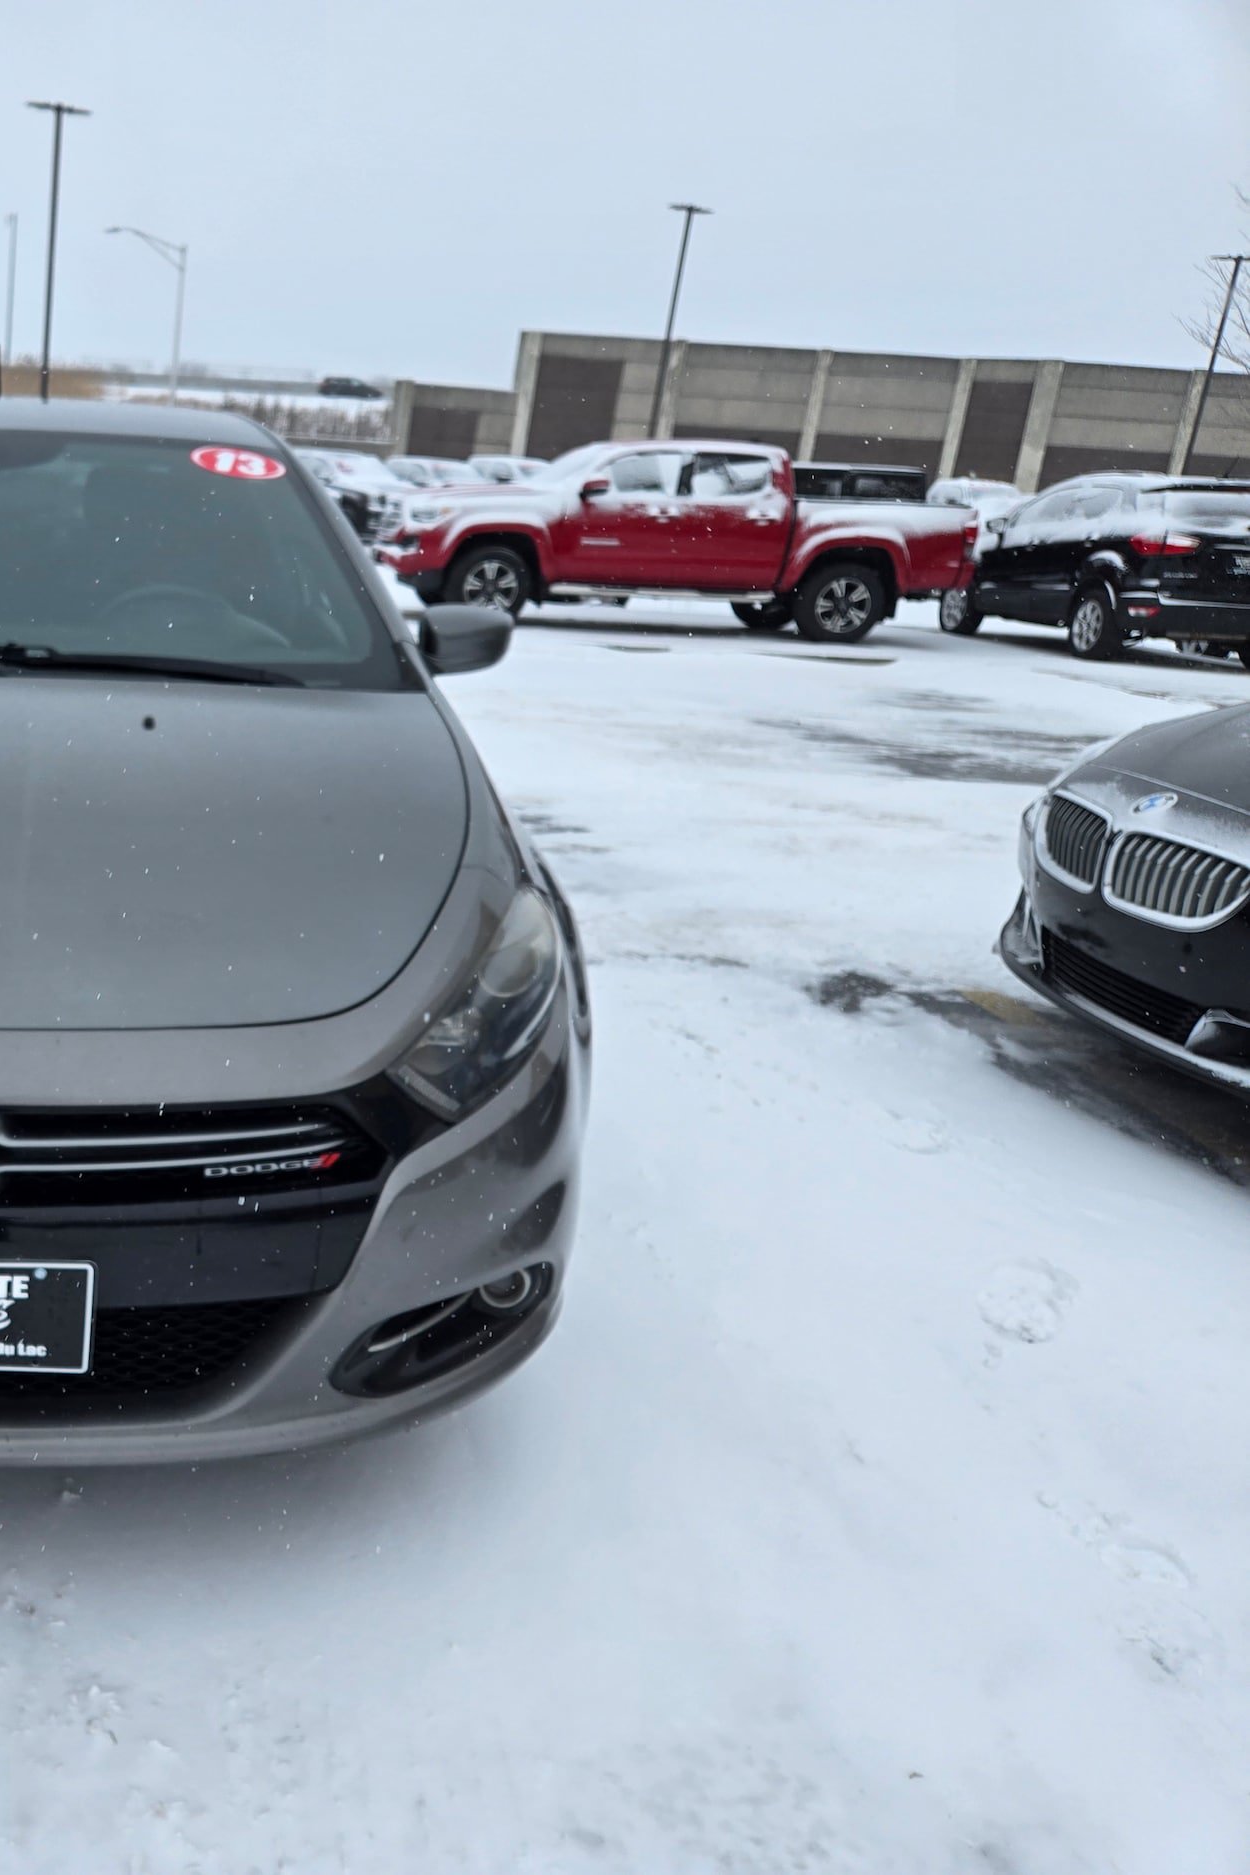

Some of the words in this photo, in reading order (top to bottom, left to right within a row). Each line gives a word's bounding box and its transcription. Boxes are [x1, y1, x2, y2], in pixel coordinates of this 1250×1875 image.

[215, 450, 267, 476] 13
[204, 1158, 323, 1177] DODGE
[17, 1342, 47, 1357] Lac
